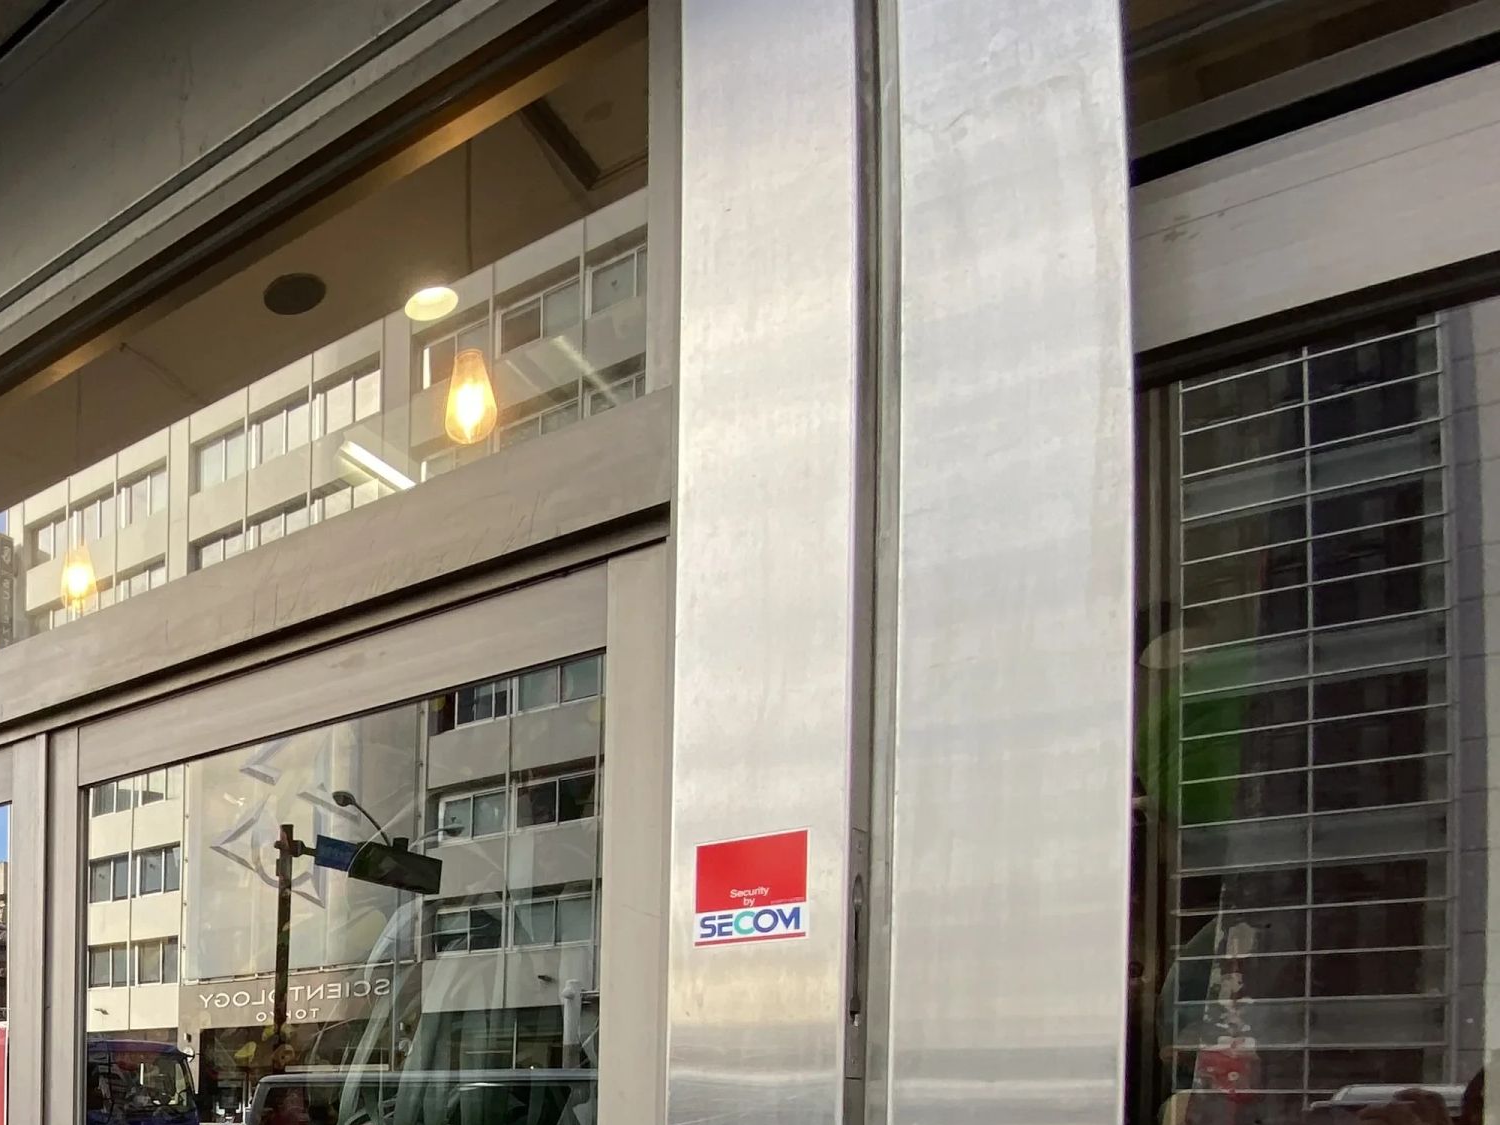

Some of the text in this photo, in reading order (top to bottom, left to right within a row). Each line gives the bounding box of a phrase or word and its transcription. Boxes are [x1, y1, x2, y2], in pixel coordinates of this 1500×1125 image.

[729, 886, 770, 899] Security
[743, 897, 756, 909] by
[699, 906, 801, 939] SECOM
